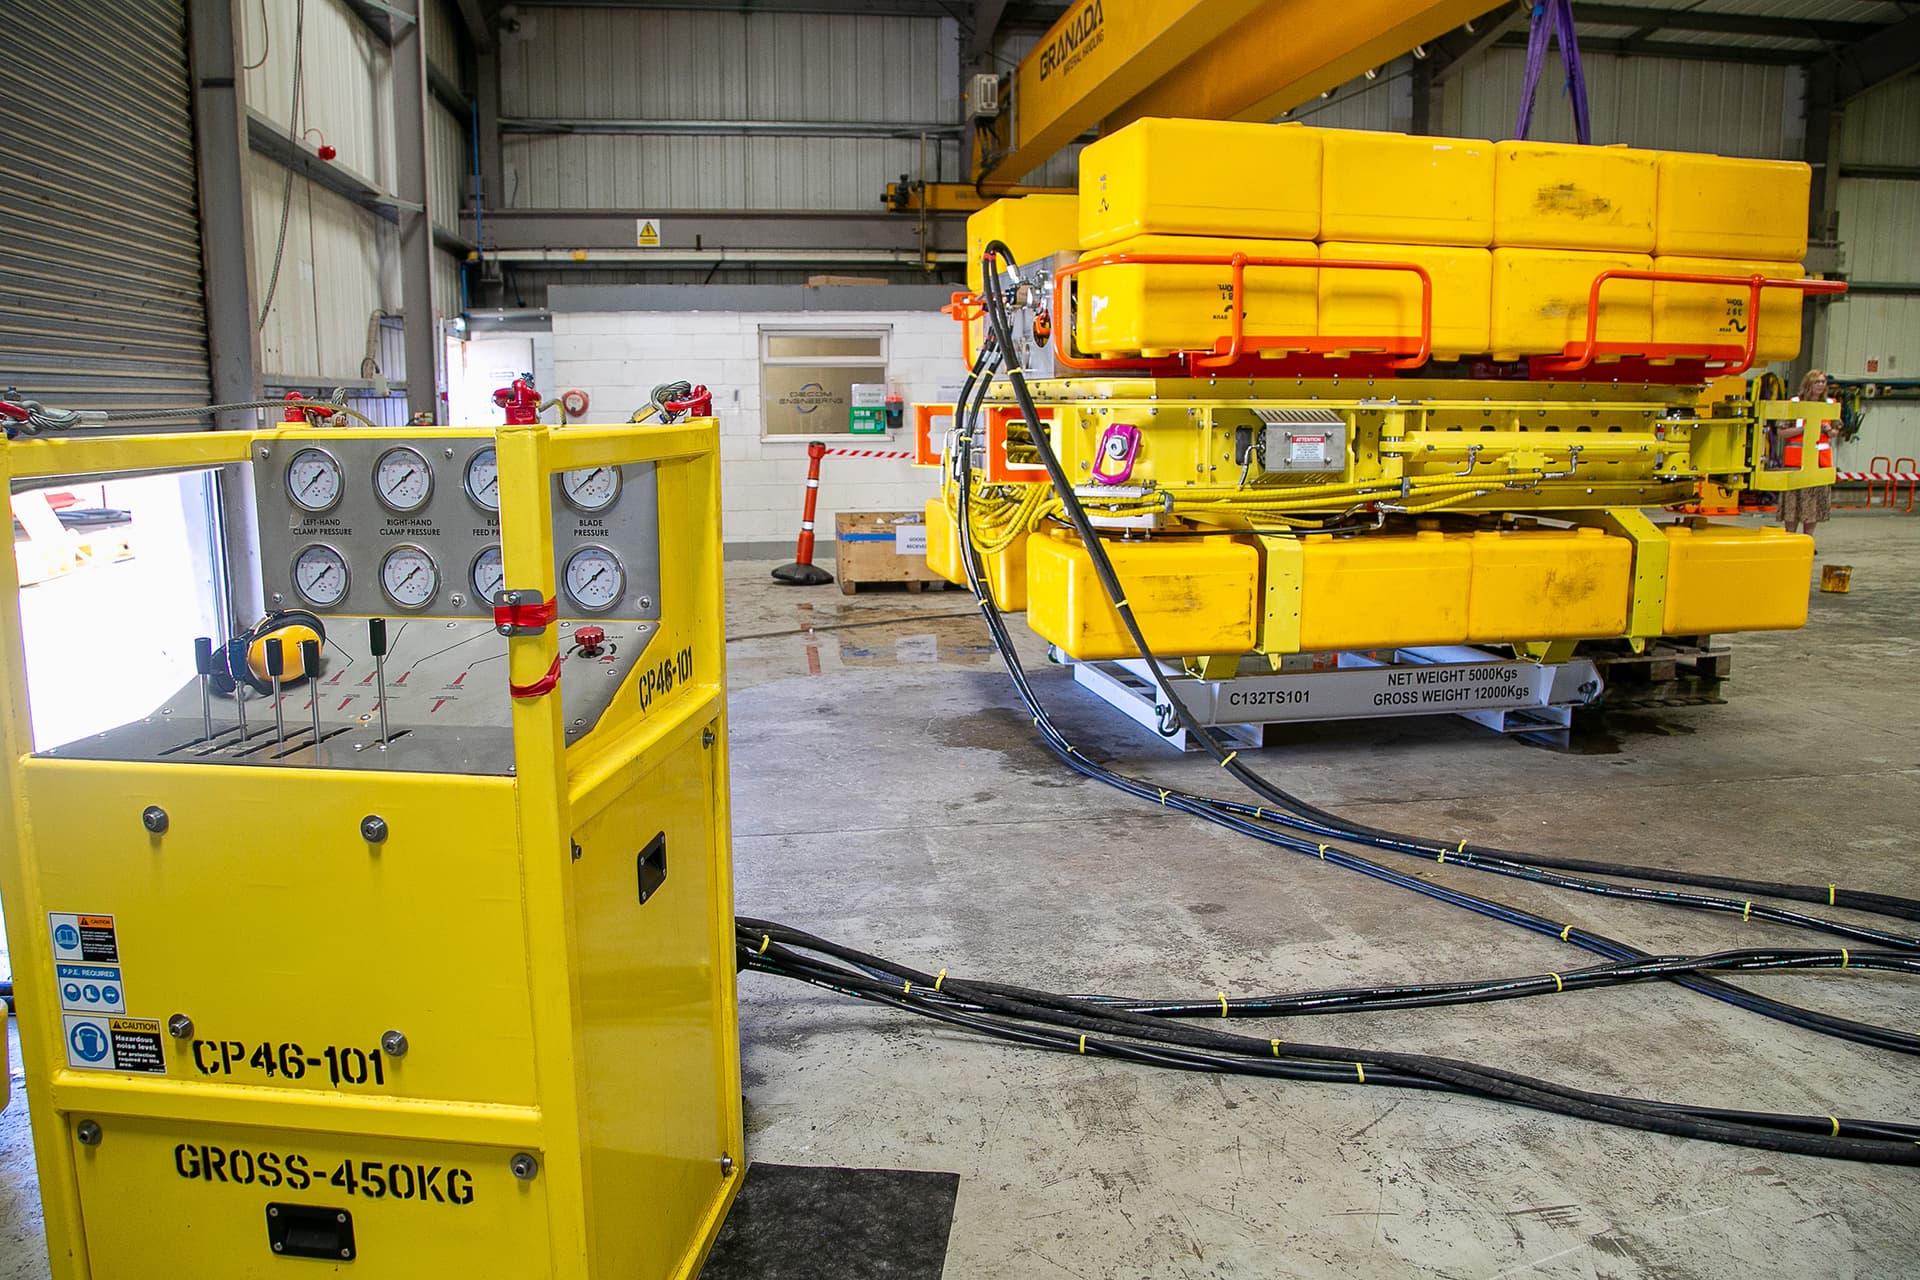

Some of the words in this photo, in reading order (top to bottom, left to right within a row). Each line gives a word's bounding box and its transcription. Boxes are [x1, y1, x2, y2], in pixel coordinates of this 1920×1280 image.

[1040, 0, 1104, 82] GRANADA
[779, 397, 843, 405] ENGINEERING
[579, 519, 603, 527] BLADE
[293, 528, 318, 536] CLAMP
[319, 528, 352, 536] PRESSURE
[379, 528, 404, 536] CLAMP
[406, 528, 440, 536] PRESSURE
[472, 528, 490, 536] FEED
[573, 529, 609, 537] PRESSURE
[639, 645, 693, 713] CP46-101
[1388, 672, 1413, 686] NET
[1416, 669, 1466, 684] WEIGHT
[1469, 667, 1518, 682] 5000Kgs
[1229, 690, 1310, 705] C132TS101
[1373, 691, 1418, 706] GROSS
[1422, 688, 1471, 702] WEIGHT
[1474, 685, 1529, 700] 12000Kgs
[81, 969, 115, 978] REQUIRED
[121, 1020, 157, 1031] CAUTION
[115, 1034, 153, 1043] Hazardous
[138, 1043, 158, 1051] level.
[191, 1039, 384, 1088] CP46-101
[174, 1143, 474, 1205] GROSS-450KG
